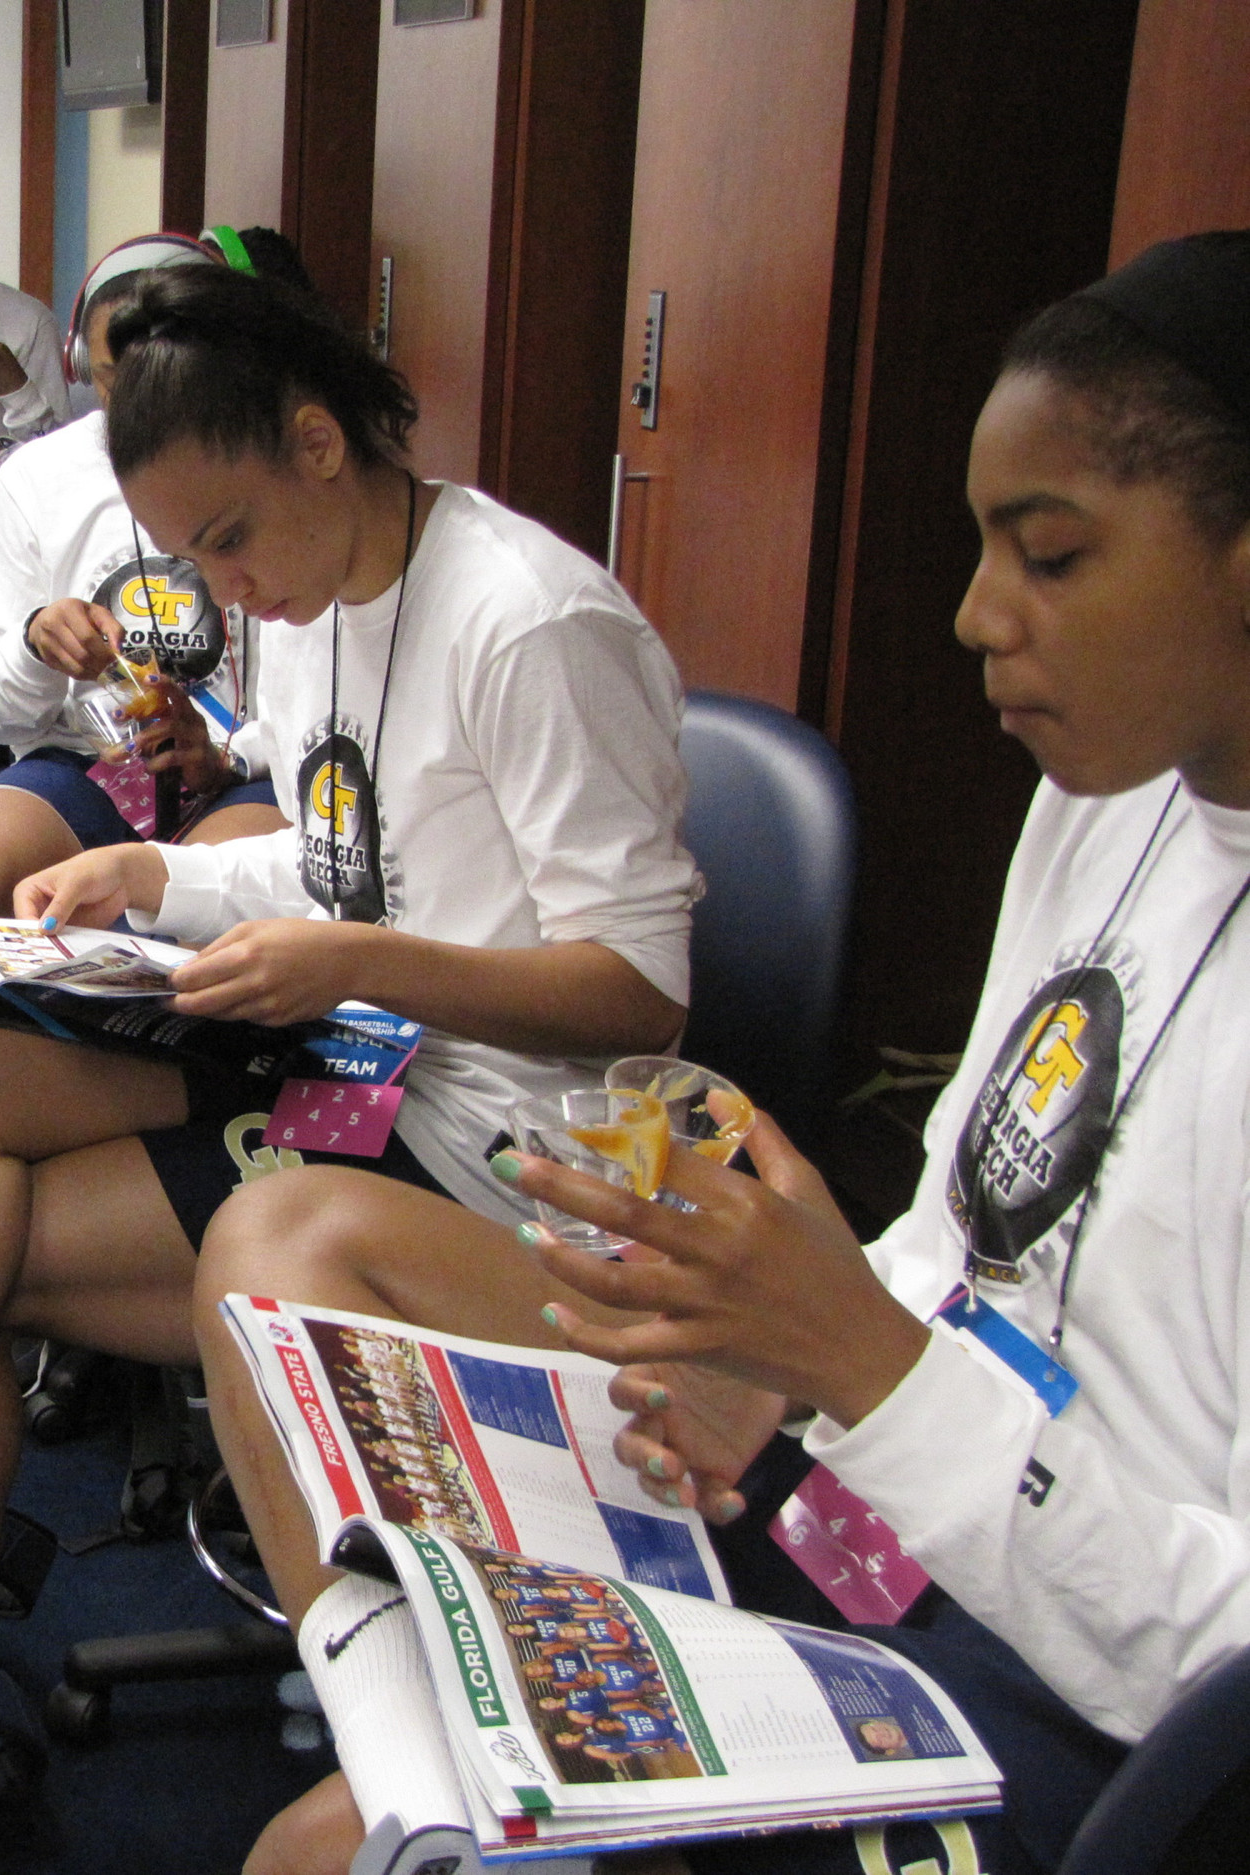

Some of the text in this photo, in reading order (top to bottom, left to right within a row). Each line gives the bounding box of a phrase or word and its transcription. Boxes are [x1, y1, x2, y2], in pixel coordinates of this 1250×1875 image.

[119, 575, 196, 627] GT
[120, 629, 207, 650] ORGIA
[310, 761, 358, 836] GT
[305, 832, 366, 871] EORGIA
[348, 1019, 394, 1029] BASKETBALL
[356, 1026, 397, 1036] IONSHIP
[324, 1058, 379, 1076] TEAM
[1021, 999, 1089, 1117] GT
[301, 1086, 380, 1105] 1 2 3
[308, 1109, 361, 1125] 4 5
[282, 1127, 340, 1145] 6 7
[283, 1350, 343, 1466] FRESNO STATE
[789, 1524, 808, 1545] 6
[829, 1517, 847, 1535] 4
[421, 1546, 460, 1601] GULF
[451, 1607, 501, 1719] FLORIDA
[637, 1716, 656, 1733] 22
